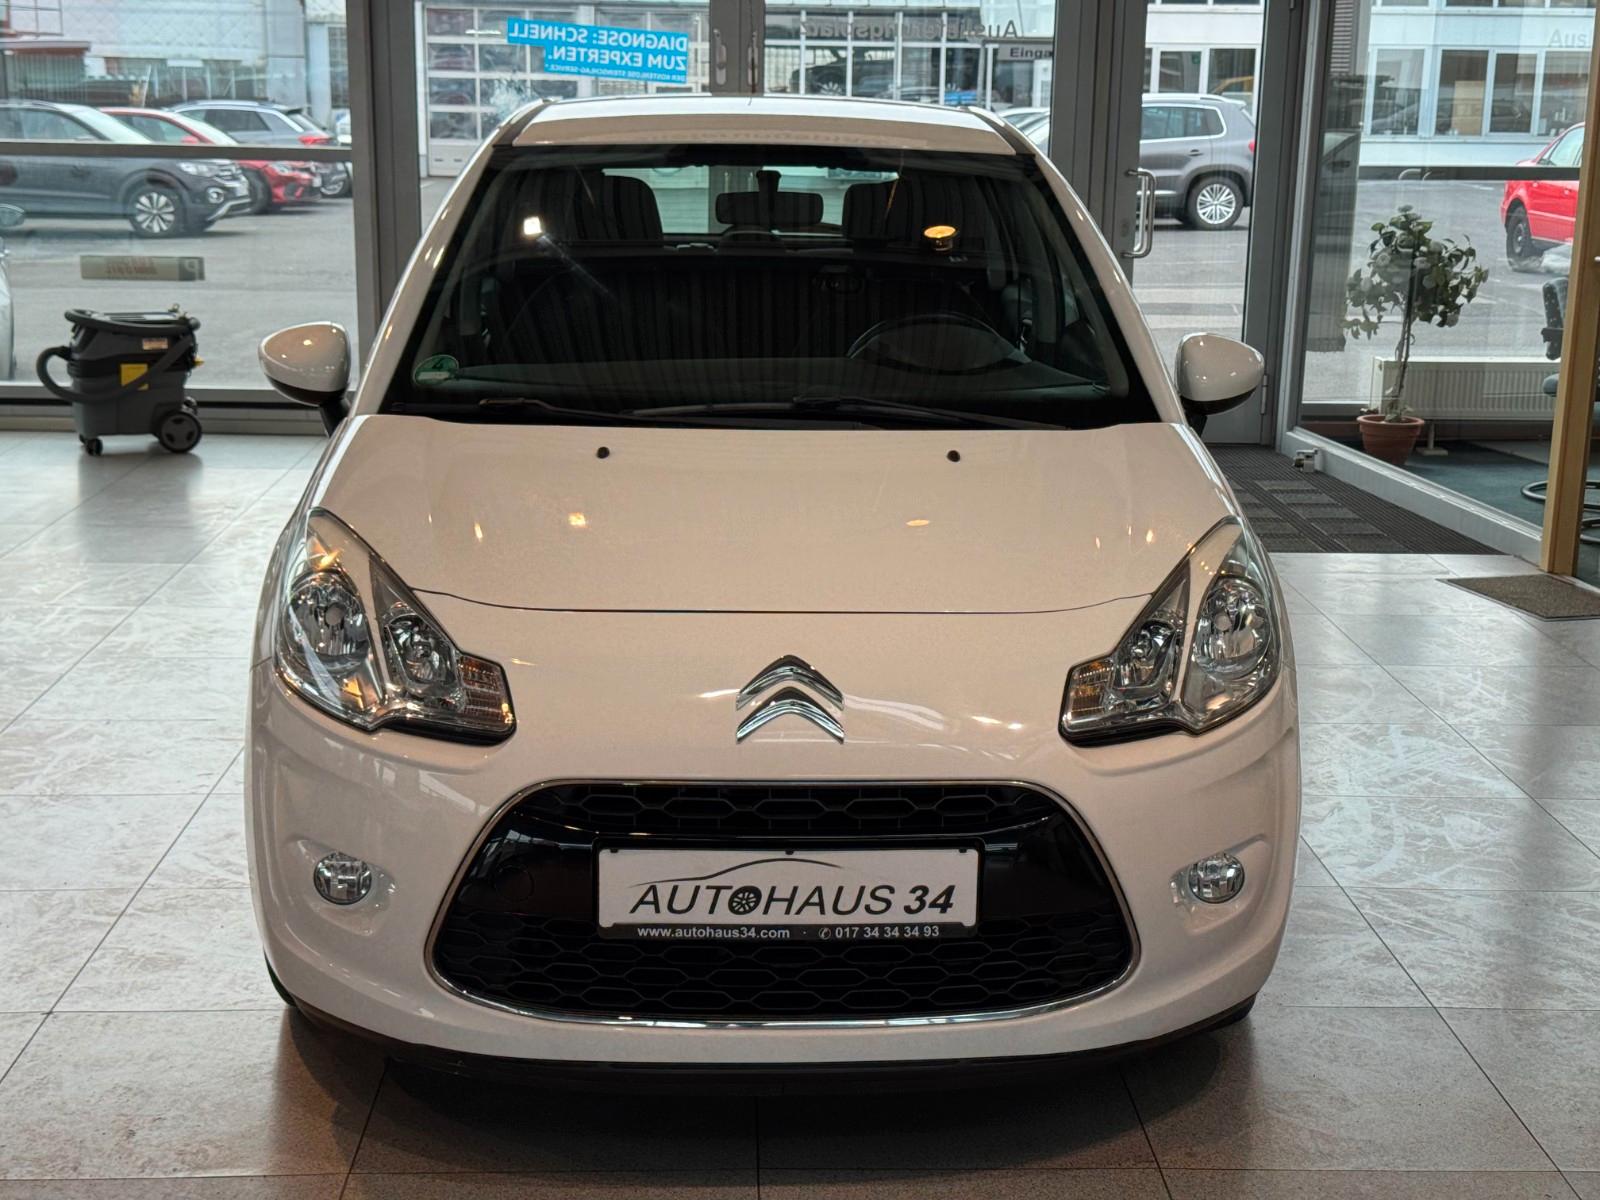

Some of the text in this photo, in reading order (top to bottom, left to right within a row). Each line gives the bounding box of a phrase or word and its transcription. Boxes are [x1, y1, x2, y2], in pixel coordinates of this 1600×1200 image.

[629, 884, 956, 916] AUTOHAUS 34
[637, 925, 940, 939] www.autohaus34.com 017 34 34 34 93
